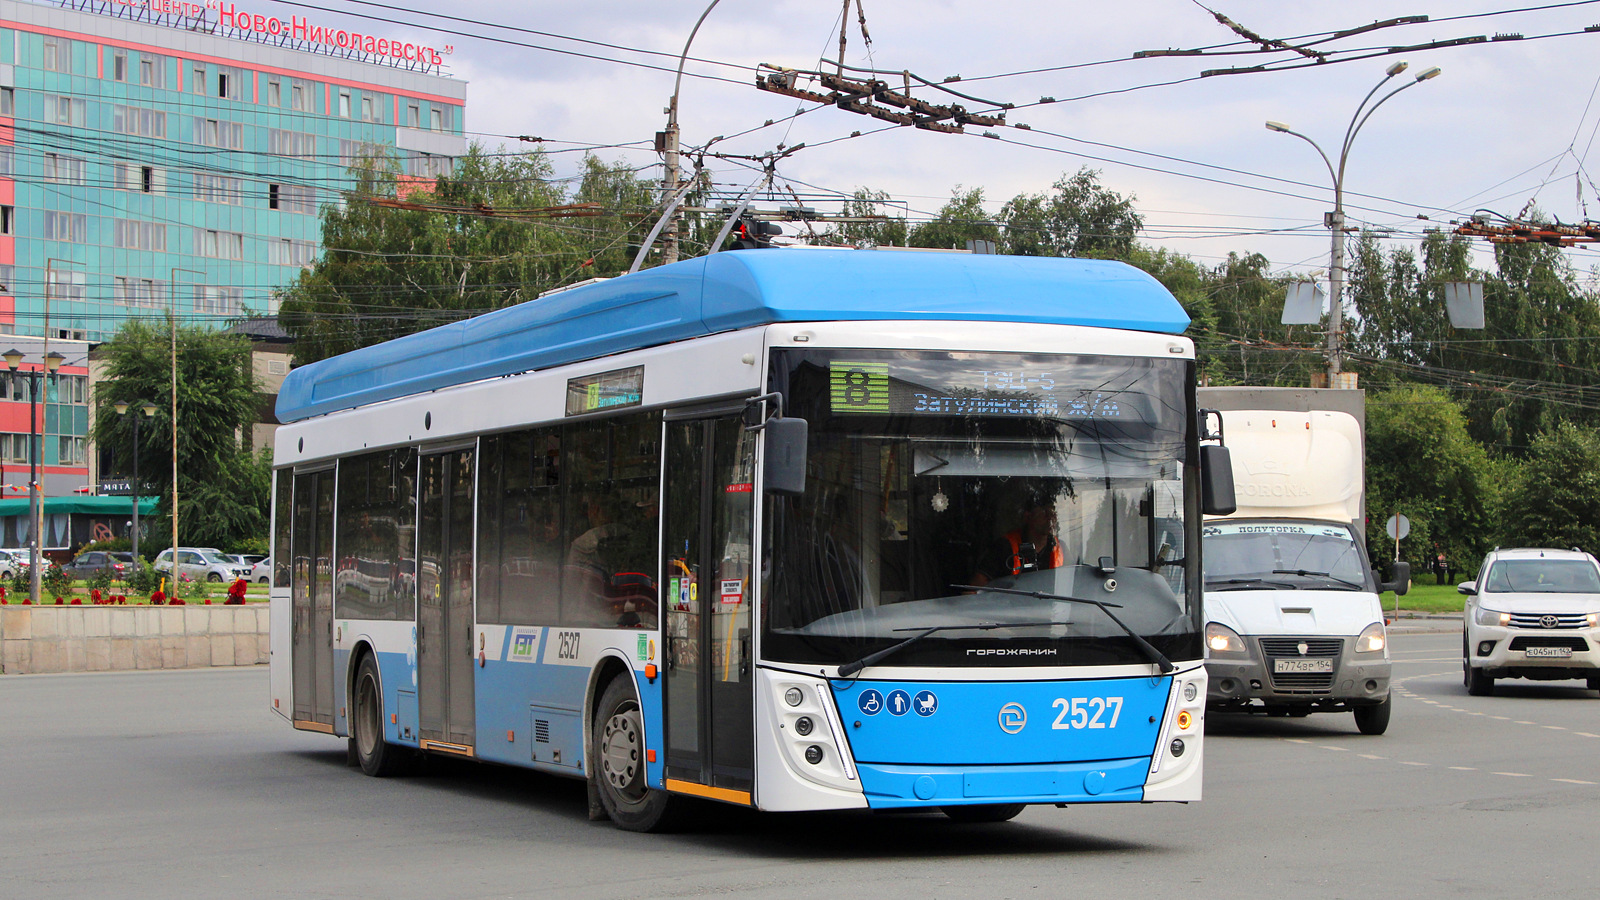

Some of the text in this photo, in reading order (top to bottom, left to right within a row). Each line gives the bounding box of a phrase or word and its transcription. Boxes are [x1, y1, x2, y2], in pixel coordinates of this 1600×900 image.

[978, 370, 1055, 392] ТЭЦ-5
[914, 392, 1058, 416] Затулинский
[103, 483, 131, 491] МЯТА
[1238, 526, 1306, 534] ПОЛУТОРКА
[558, 631, 581, 660] 2527
[966, 648, 1058, 656] ГОРОЖАНИН
[1051, 697, 1124, 730] 2527
